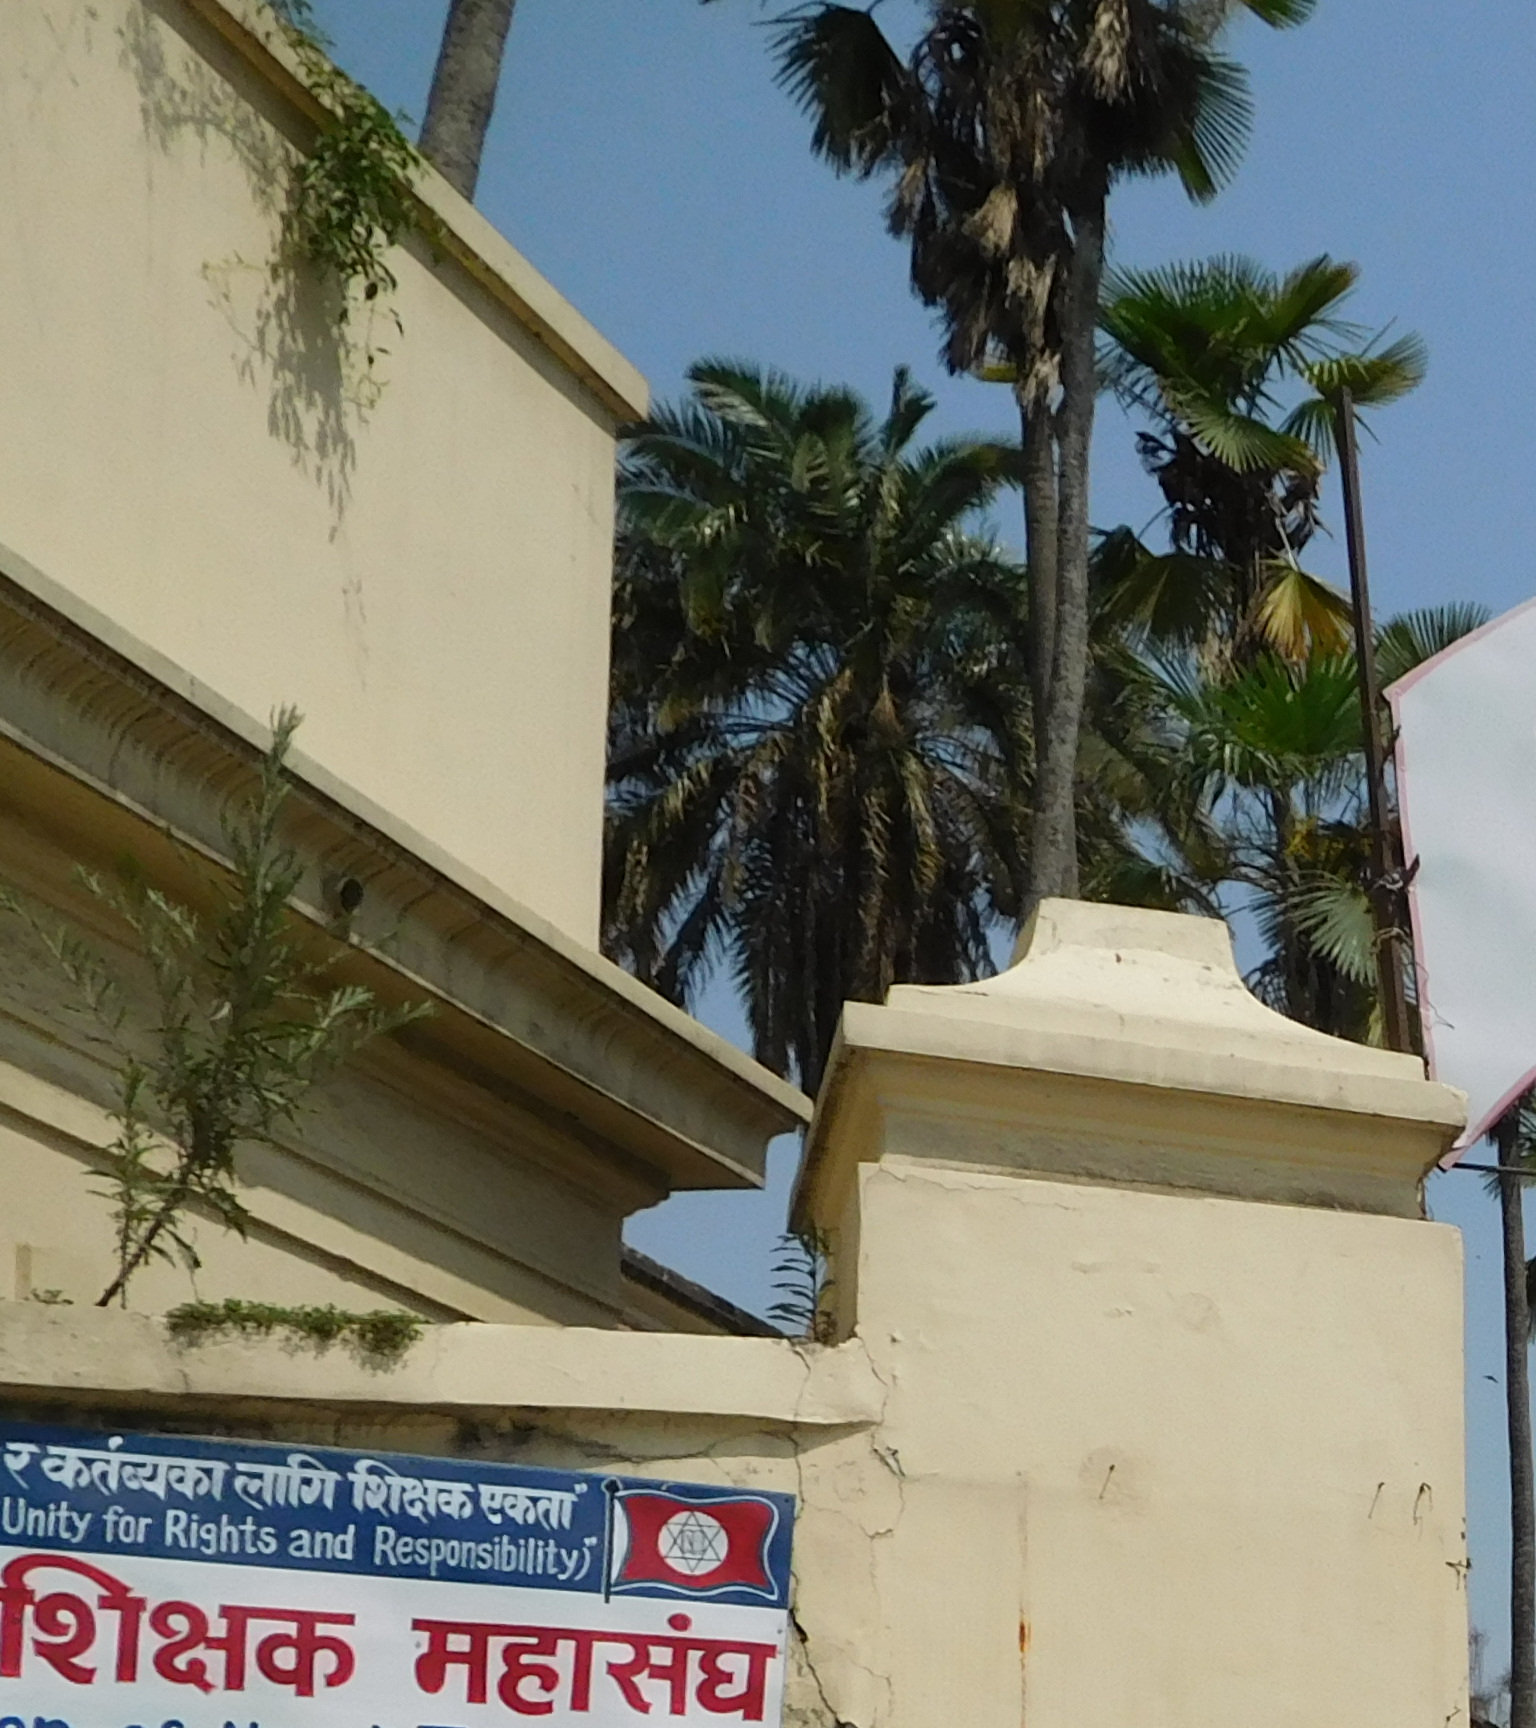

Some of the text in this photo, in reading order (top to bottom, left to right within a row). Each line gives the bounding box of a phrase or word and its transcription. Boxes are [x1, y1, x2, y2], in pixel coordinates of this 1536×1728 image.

[3, 1440, 41, 1491] र
[233, 1452, 343, 1512] लागि
[347, 1457, 475, 1524] शिक्षक
[102, 1505, 153, 1544] for
[164, 1508, 279, 1556] Rights
[288, 1524, 356, 1561] and
[410, 1612, 779, 1722] महासंघ
